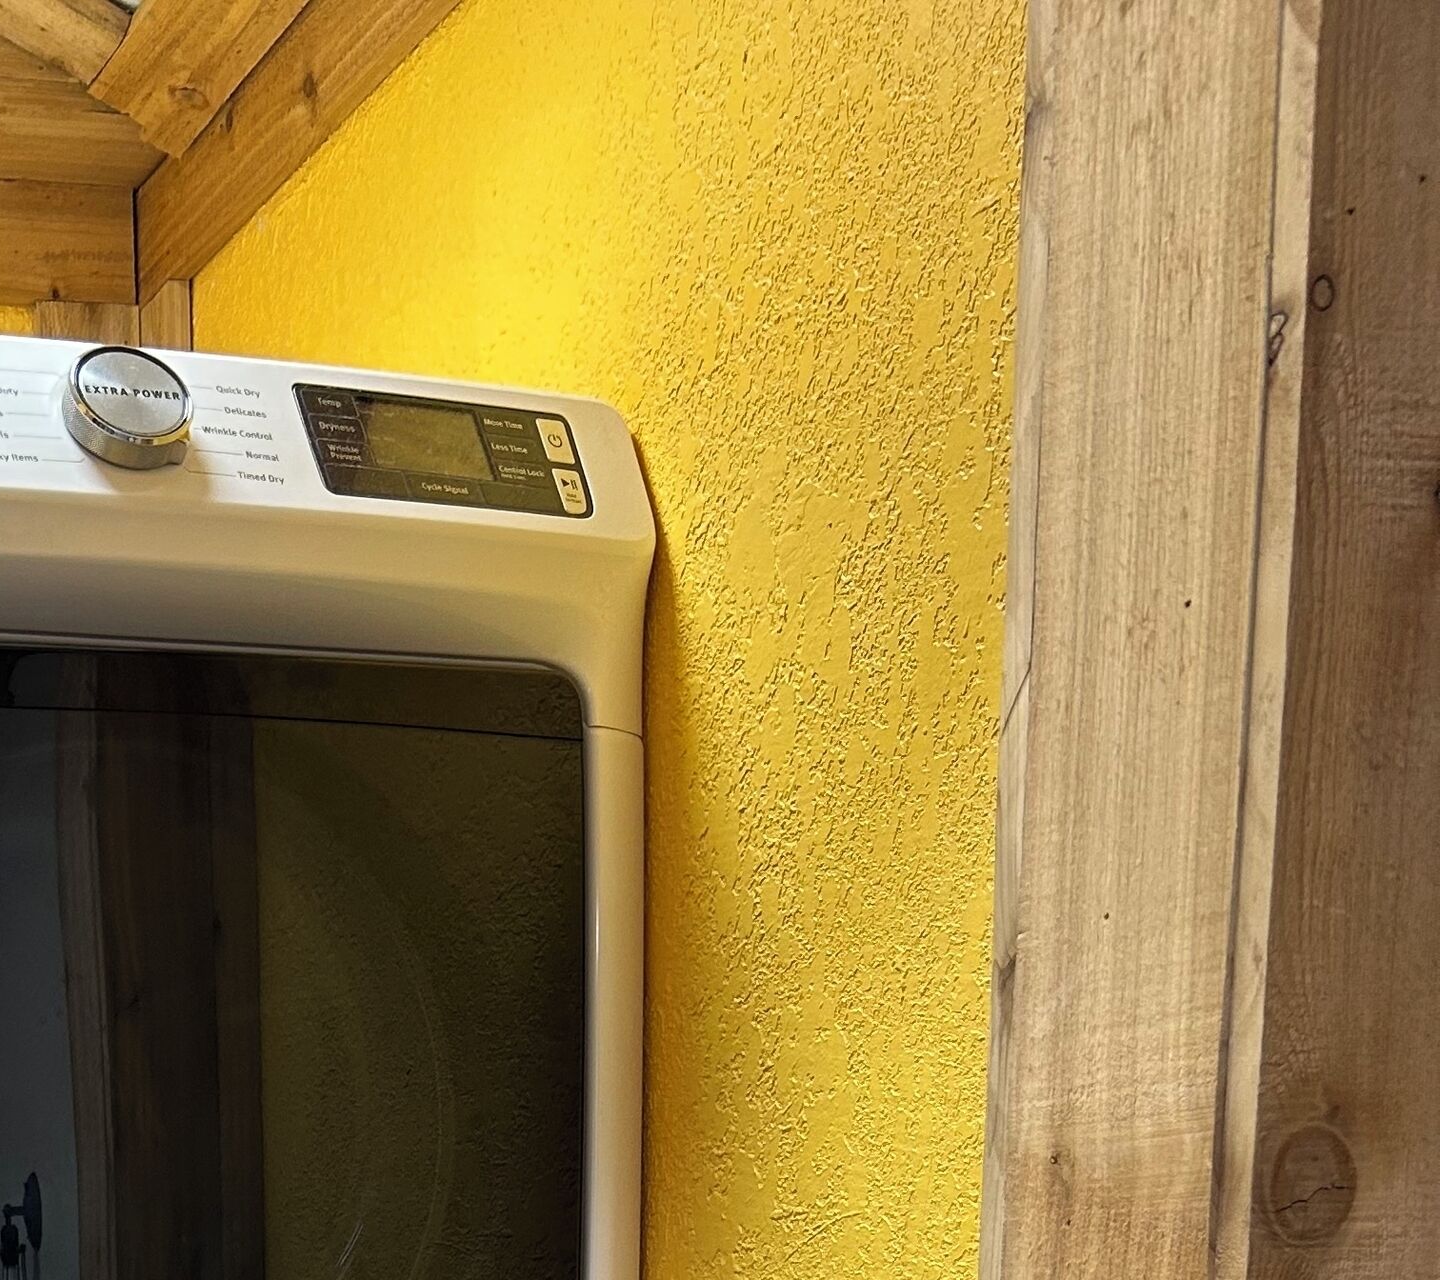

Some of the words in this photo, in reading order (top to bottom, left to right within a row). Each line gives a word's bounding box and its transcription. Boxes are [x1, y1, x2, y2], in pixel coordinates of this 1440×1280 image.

[84, 385, 128, 396] EXTRA
[133, 389, 181, 400] POWER
[216, 385, 242, 396] Quick
[243, 389, 260, 398] Dry
[318, 397, 341, 408] Temp
[224, 406, 267, 418] Delicates
[201, 425, 237, 437] Wrinkle
[239, 429, 273, 440] Control
[319, 421, 355, 432] Dryness
[491, 443, 509, 452] Less
[510, 445, 528, 454] Time
[11, 453, 39, 462] Items
[245, 451, 279, 462] Normal
[237, 471, 267, 482] Timed
[268, 474, 285, 485] Dry
[422, 482, 443, 492] Cycle
[444, 484, 469, 495] Signal
